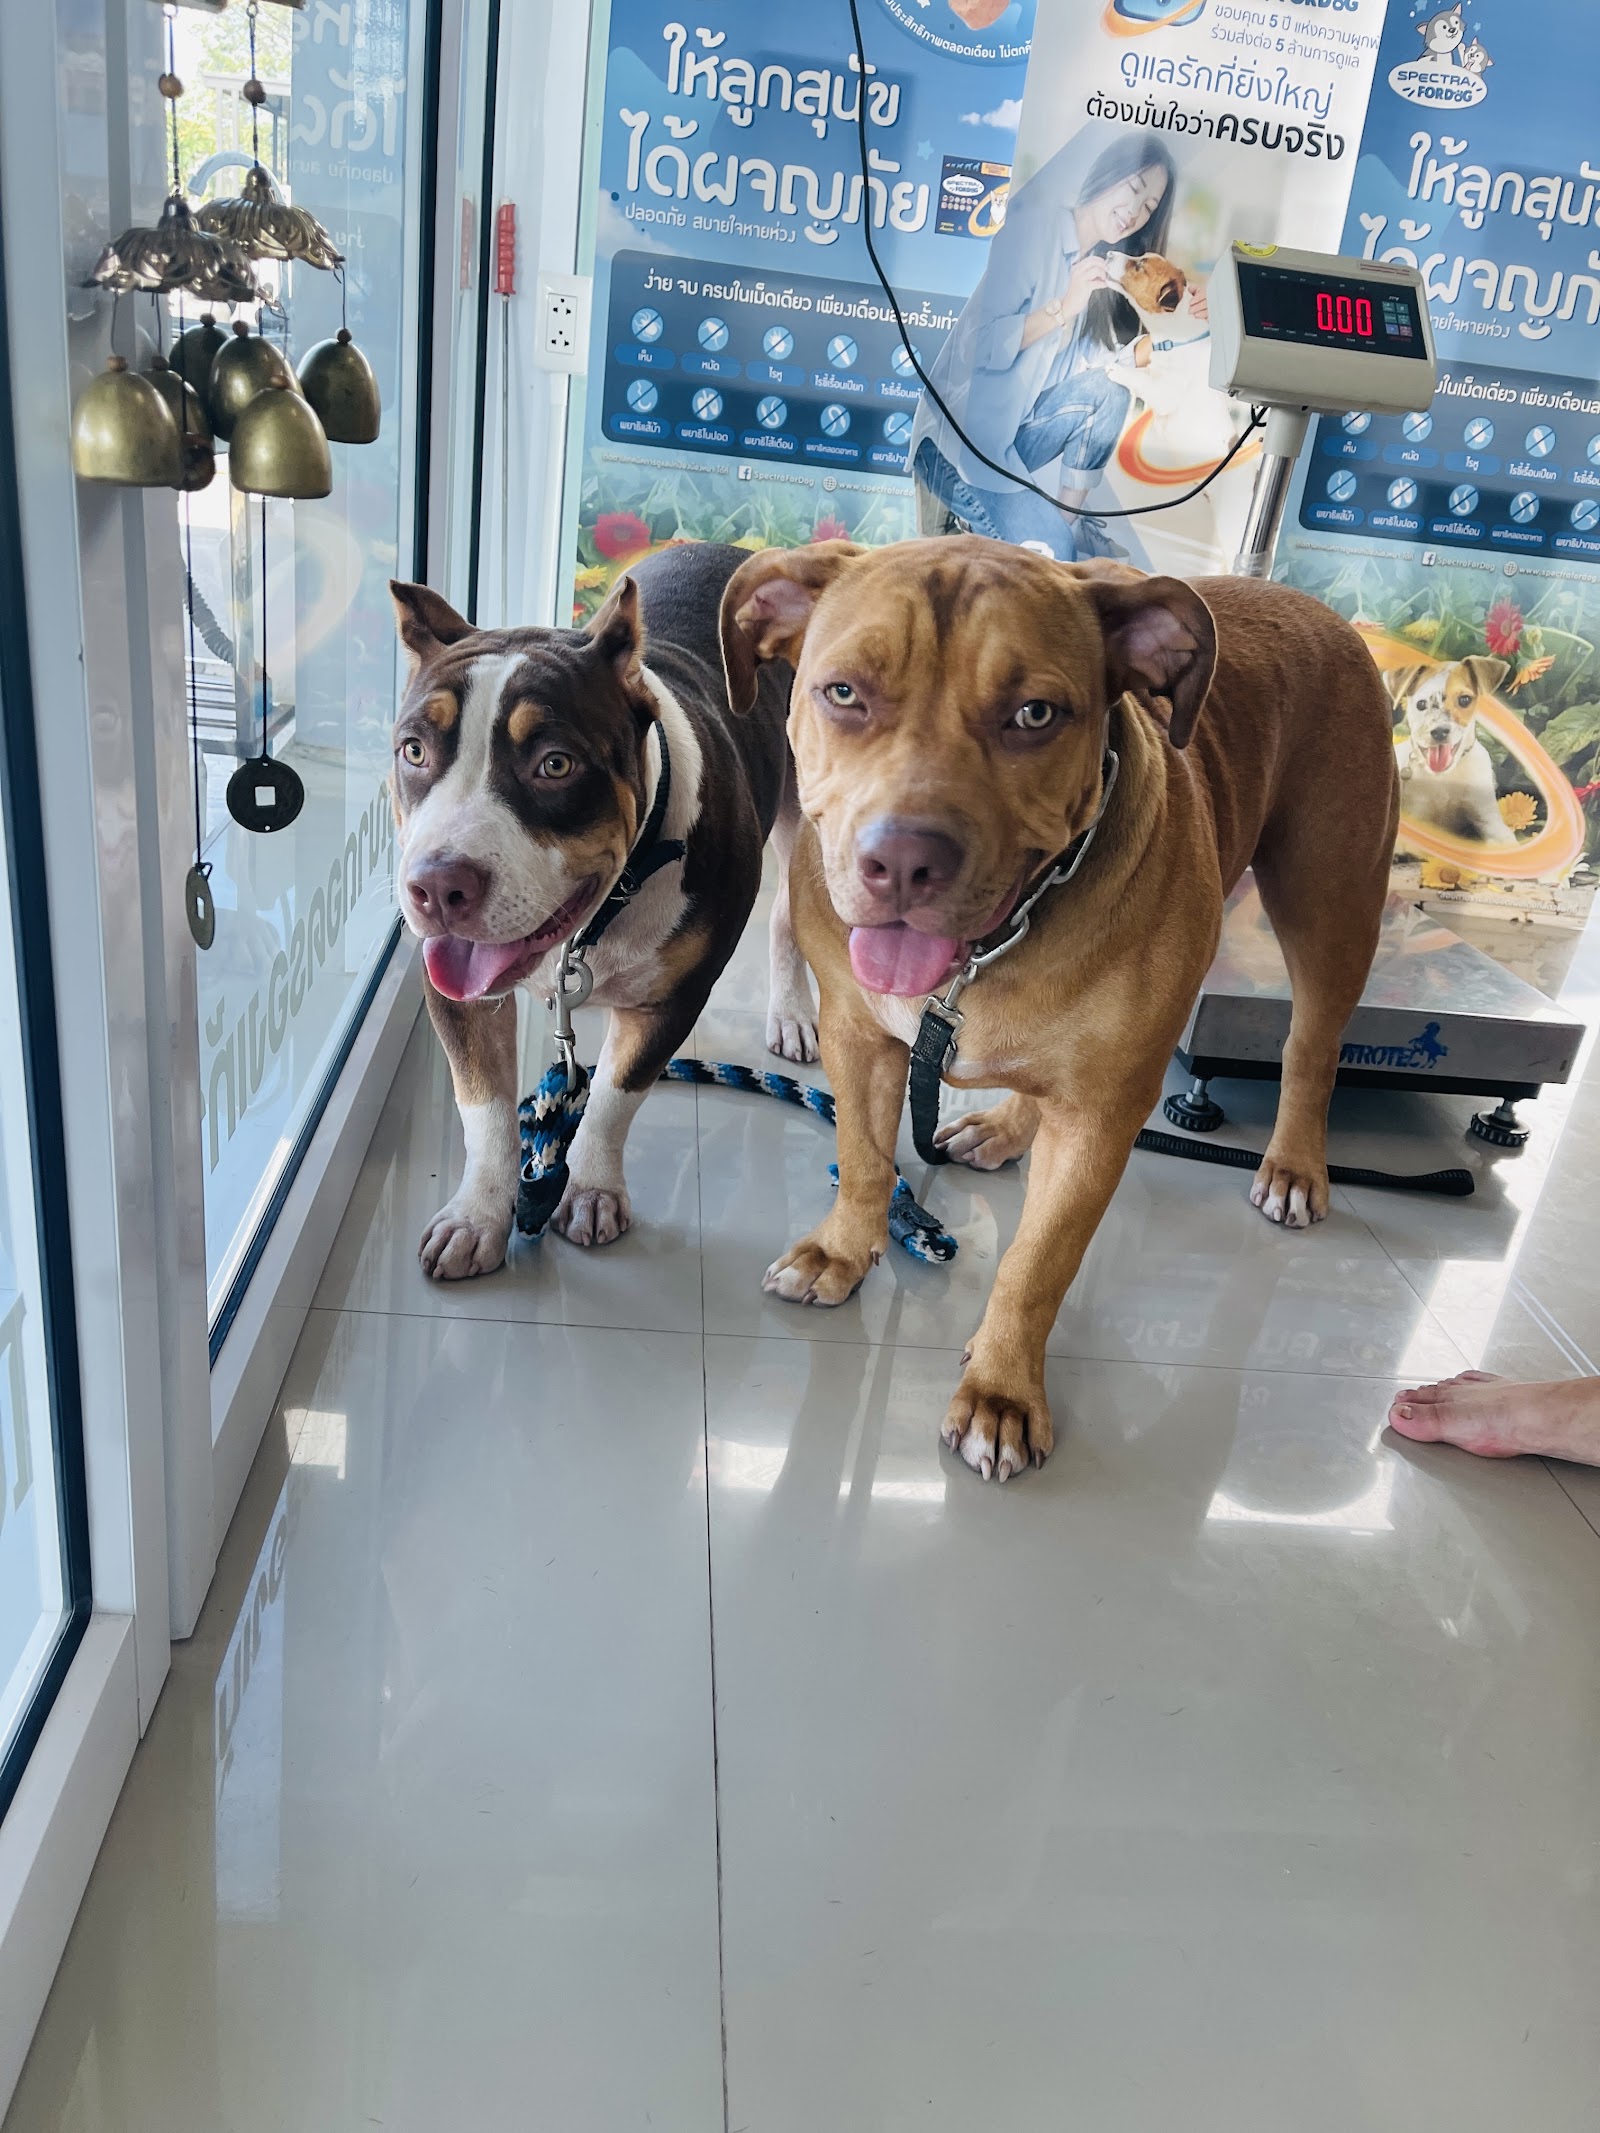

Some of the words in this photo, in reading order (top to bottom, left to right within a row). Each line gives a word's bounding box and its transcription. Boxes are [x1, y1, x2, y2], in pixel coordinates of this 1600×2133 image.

[1216, 5, 1265, 27] ขอบคุณ
[1269, 14, 1278, 28] 5
[1282, 15, 1292, 31] ปี
[1211, 23, 1271, 49] ร่วมส่งต่อ
[1275, 38, 1285, 52] 5
[1287, 39, 1360, 70] ล้านการดูแล
[663, 22, 901, 139] ให้ลูกสุนัข
[1120, 51, 1334, 120] ดูแลรักที่ยิ่งใหญ่
[1397, 71, 1470, 87] SPECTRA
[1086, 91, 1346, 161] ต้องมั่นใจว่าครบจริง
[619, 108, 931, 245] ได้ผจญภัย
[1407, 131, 1600, 241] ให้ลูกสุนั
[625, 202, 687, 227] ปลอดภัย
[693, 214, 796, 243] สบายใจหายห่วง
[644, 268, 673, 291] ง่าย
[676, 280, 699, 295] จบ
[702, 280, 812, 312] ครบในเม็ดเดียว
[1316, 293, 1373, 337] 0.00
[1430, 311, 1511, 339] ายใจหายห่วง
[701, 359, 720, 371] หมัด
[1401, 450, 1420, 461] หมัด
